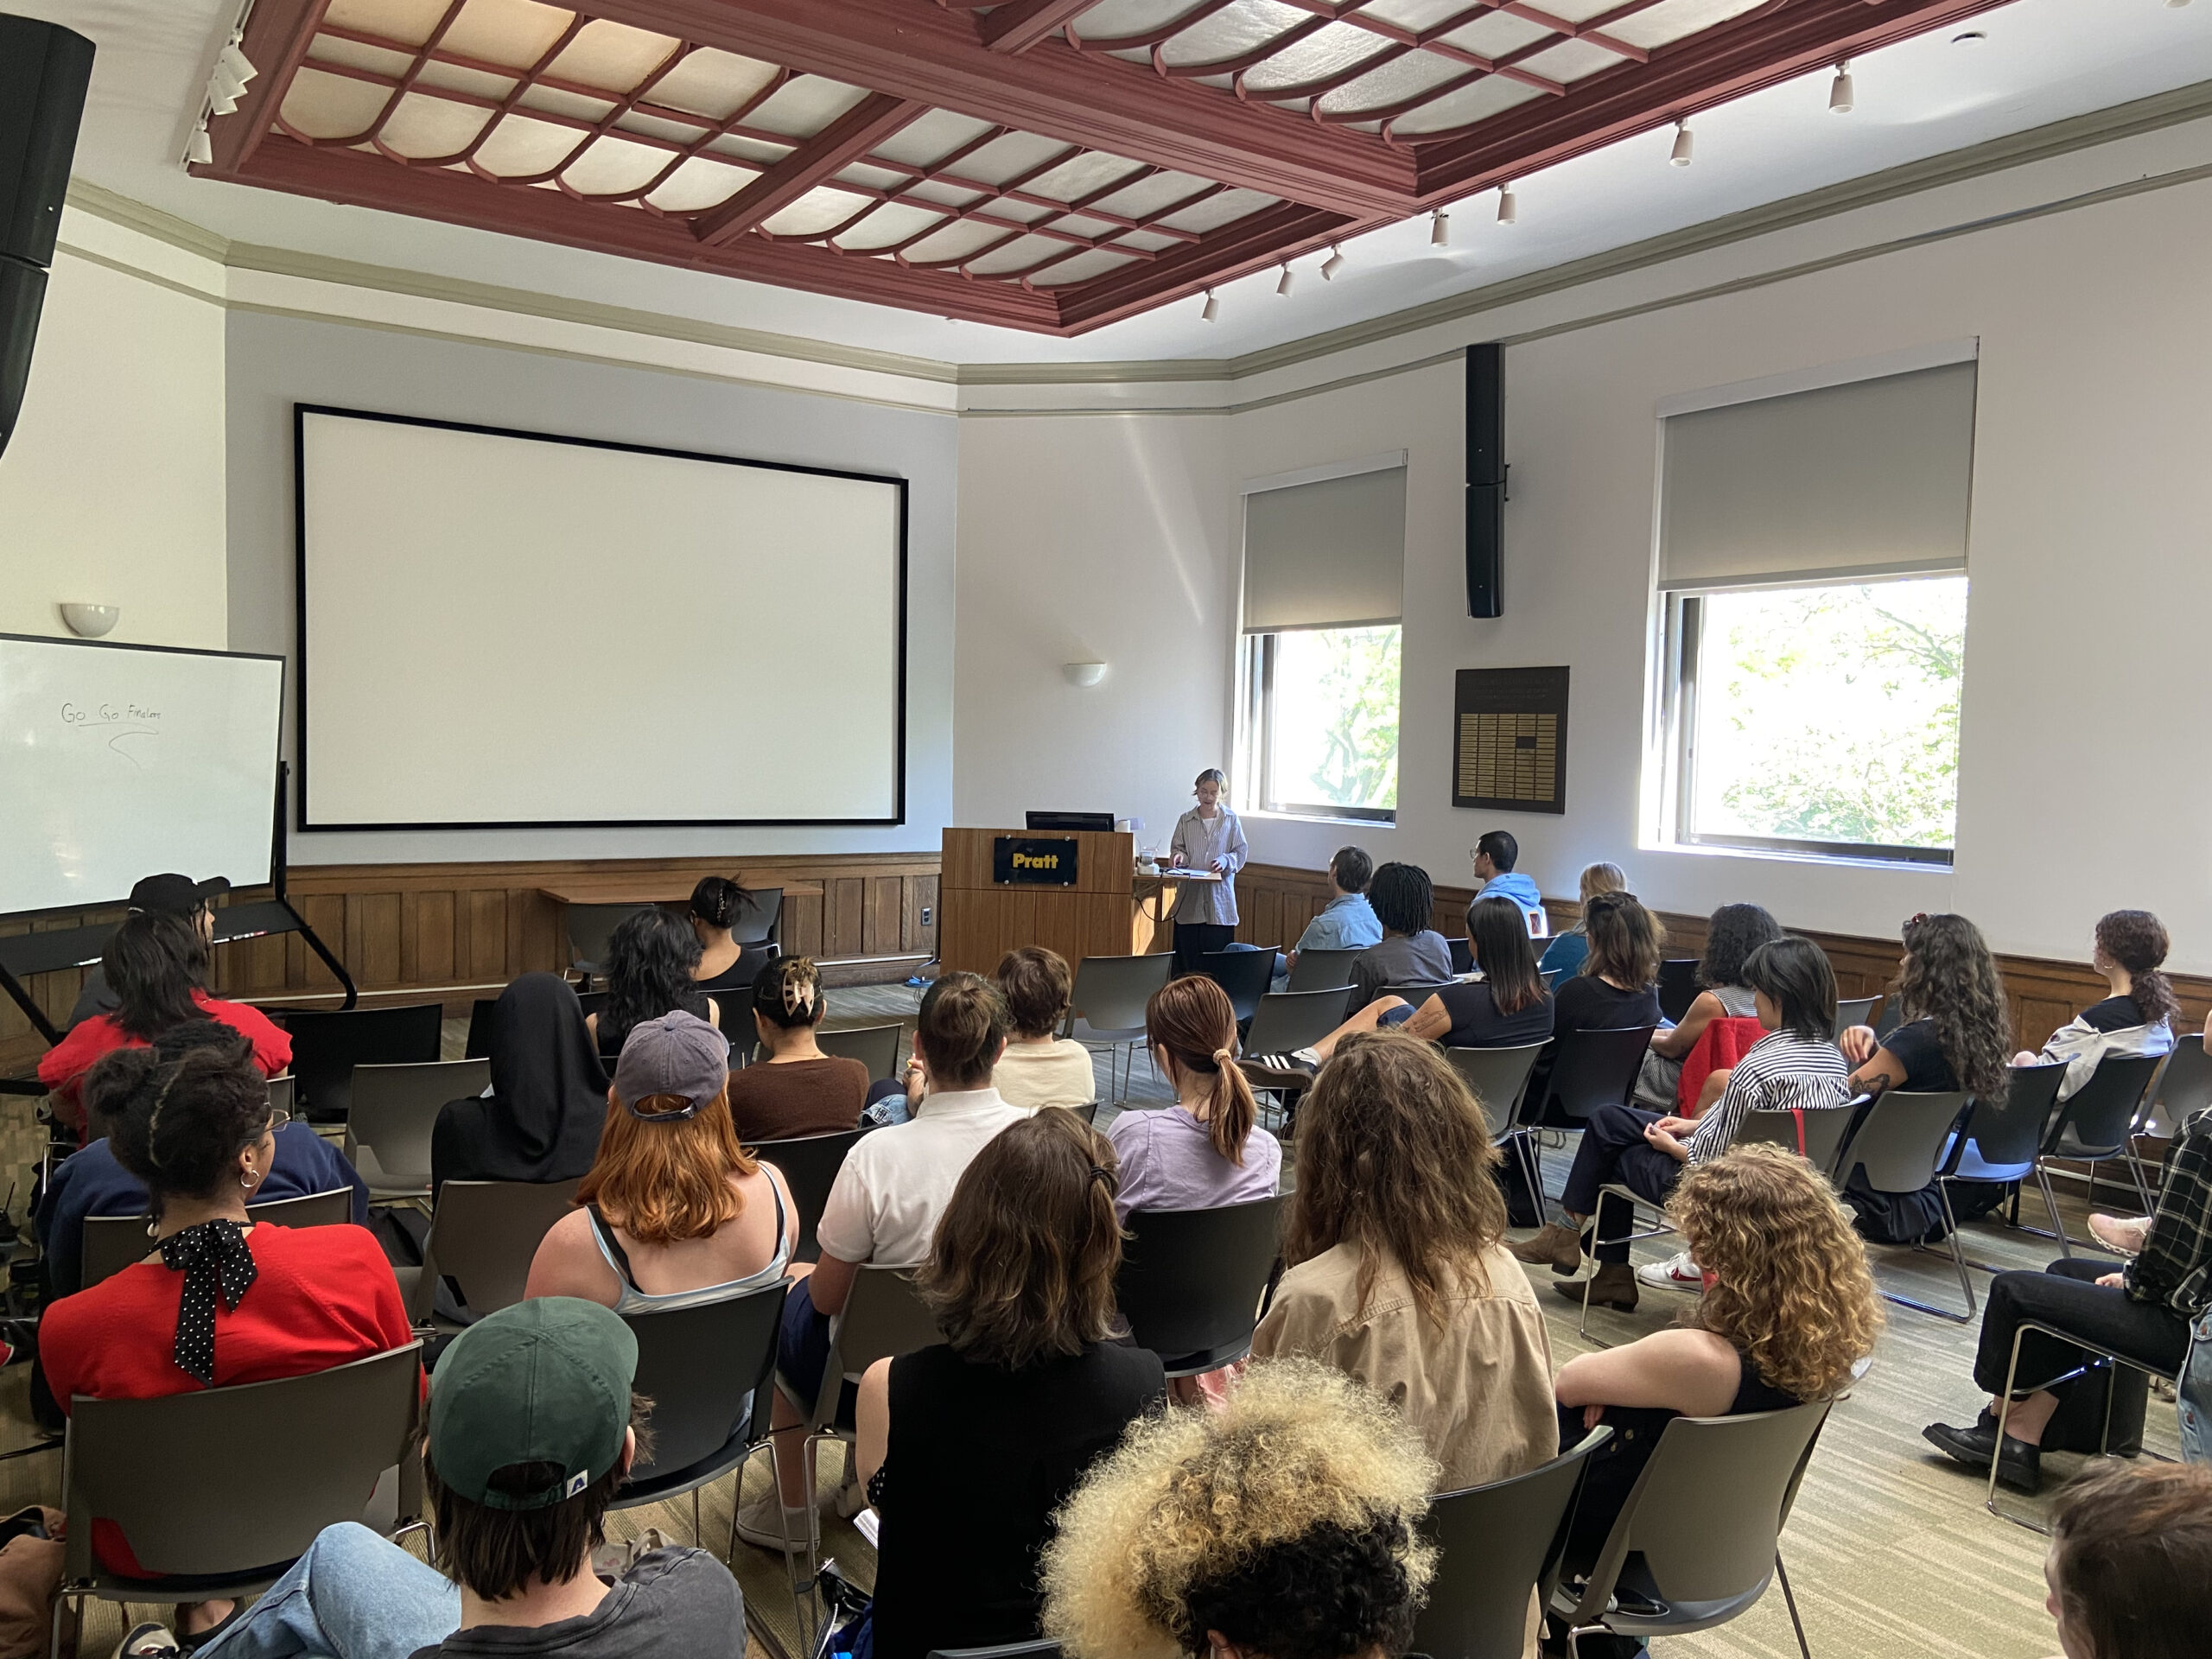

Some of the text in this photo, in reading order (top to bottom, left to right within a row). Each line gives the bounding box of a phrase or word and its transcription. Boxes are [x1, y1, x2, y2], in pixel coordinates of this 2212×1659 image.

[61, 702, 86, 723] Go
[99, 703, 119, 721] Go
[1012, 853, 1058, 869] Pratt
